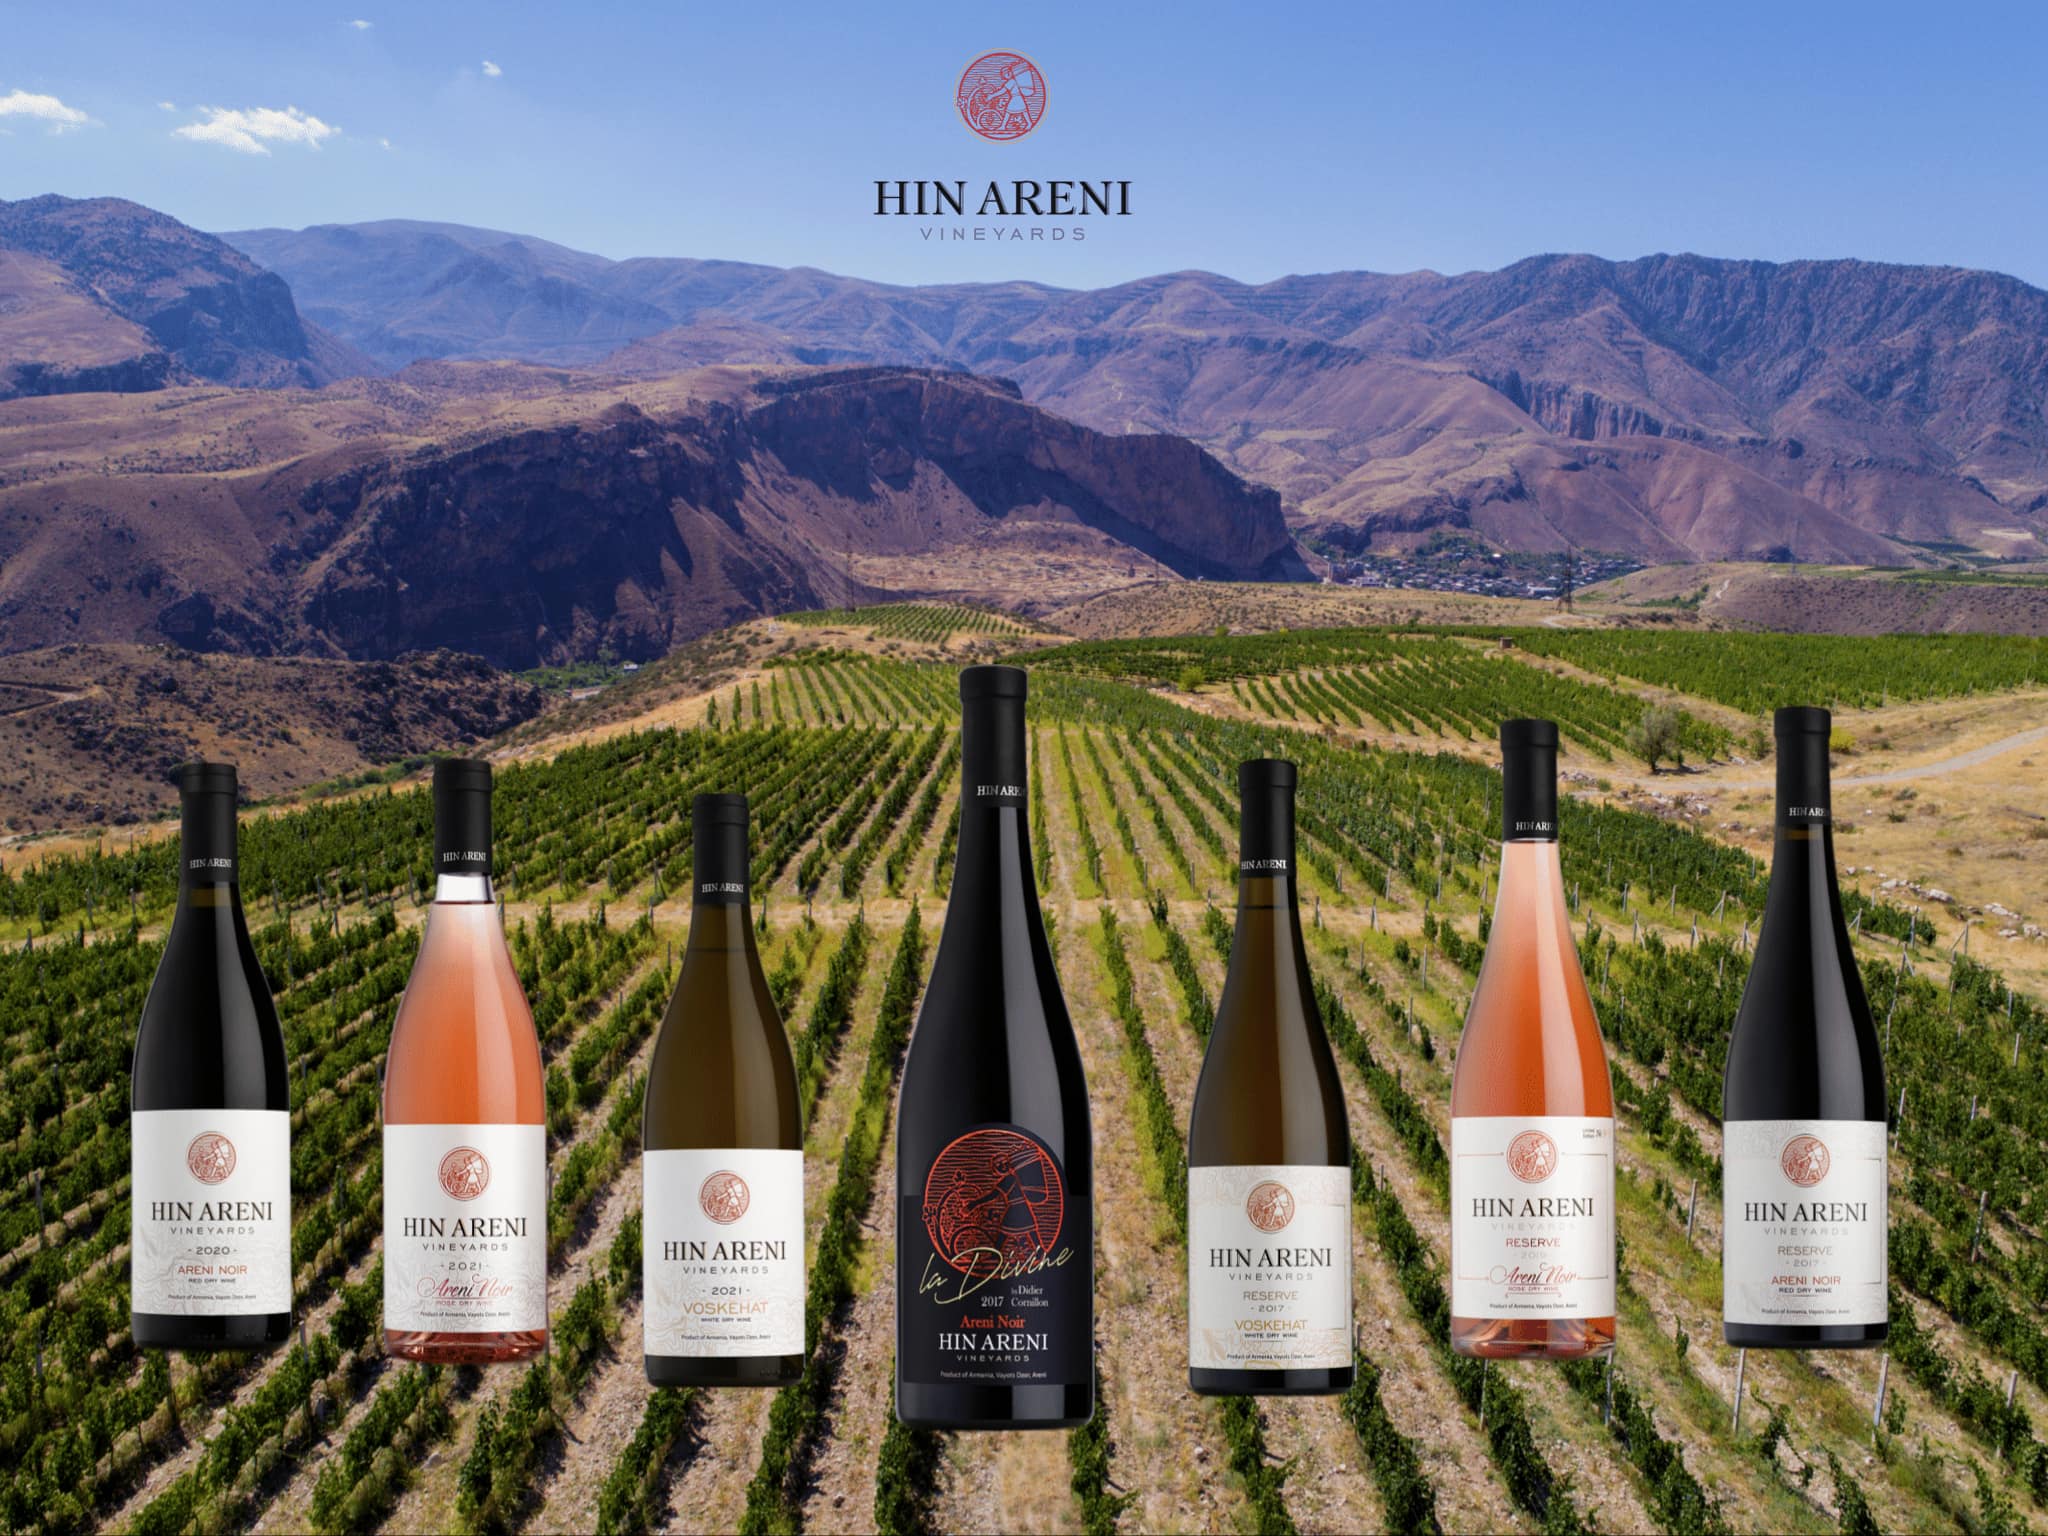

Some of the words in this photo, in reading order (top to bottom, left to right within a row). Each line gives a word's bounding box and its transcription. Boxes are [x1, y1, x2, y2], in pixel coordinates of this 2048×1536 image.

[976, 785, 999, 797] HIN
[1515, 821, 1535, 831] HIN
[443, 851, 460, 863] HIN
[461, 850, 486, 862] ARENI
[190, 859, 206, 870] HIN
[207, 858, 232, 869] ARENI
[1256, 859, 1287, 870] ARENI
[702, 882, 718, 893] HIN
[719, 882, 744, 893] ARENI
[152, 1202, 193, 1221] HIN
[198, 1202, 272, 1221] ARENI
[1473, 1198, 1514, 1217] HIN
[1520, 1198, 1594, 1217] ARENI
[1744, 1202, 1788, 1222] HIN
[1792, 1202, 1868, 1222] ARENI
[171, 1227, 255, 1236] VINEYARDS
[404, 1217, 446, 1237] HIN
[451, 1217, 528, 1237] ARENI
[1764, 1227, 1849, 1236] VINEYARDS
[422, 1243, 509, 1251] VINEYARDS
[1506, 1238, 1560, 1248] RESERVE
[196, 1246, 230, 1256] 2020
[664, 1241, 706, 1261] HIN
[712, 1241, 787, 1261] ARENI
[1777, 1246, 1832, 1256] RESERVE
[1210, 1248, 1251, 1267] HIN
[1258, 1248, 1332, 1267] ARENI
[178, 1265, 214, 1275] ARENI
[219, 1265, 248, 1275] NOIR
[448, 1261, 482, 1271] 2021
[683, 1266, 769, 1275] VINEYARDS
[934, 1244, 1075, 1304] Divine
[1229, 1273, 1313, 1281] VINEYARDS
[1490, 1264, 1542, 1284] Areni
[1539, 1262, 1577, 1283] Noir
[417, 1277, 475, 1297] Areni
[472, 1273, 513, 1297] Noir
[1771, 1275, 1807, 1285] ARENI
[1813, 1275, 1841, 1285] NOIR
[711, 1286, 743, 1296] 2021
[1018, 1284, 1044, 1295] Didier
[1243, 1291, 1298, 1300] RESERVE
[981, 1296, 1004, 1307] 2017
[1011, 1297, 1049, 1307] Cornillon
[683, 1301, 769, 1315] VOSKEHAT
[960, 1315, 994, 1328] Areni
[997, 1314, 1025, 1328] Noir
[1234, 1319, 1308, 1331] VOSKEHAT
[939, 1333, 976, 1350] HIN
[981, 1333, 1048, 1351] ARENI
